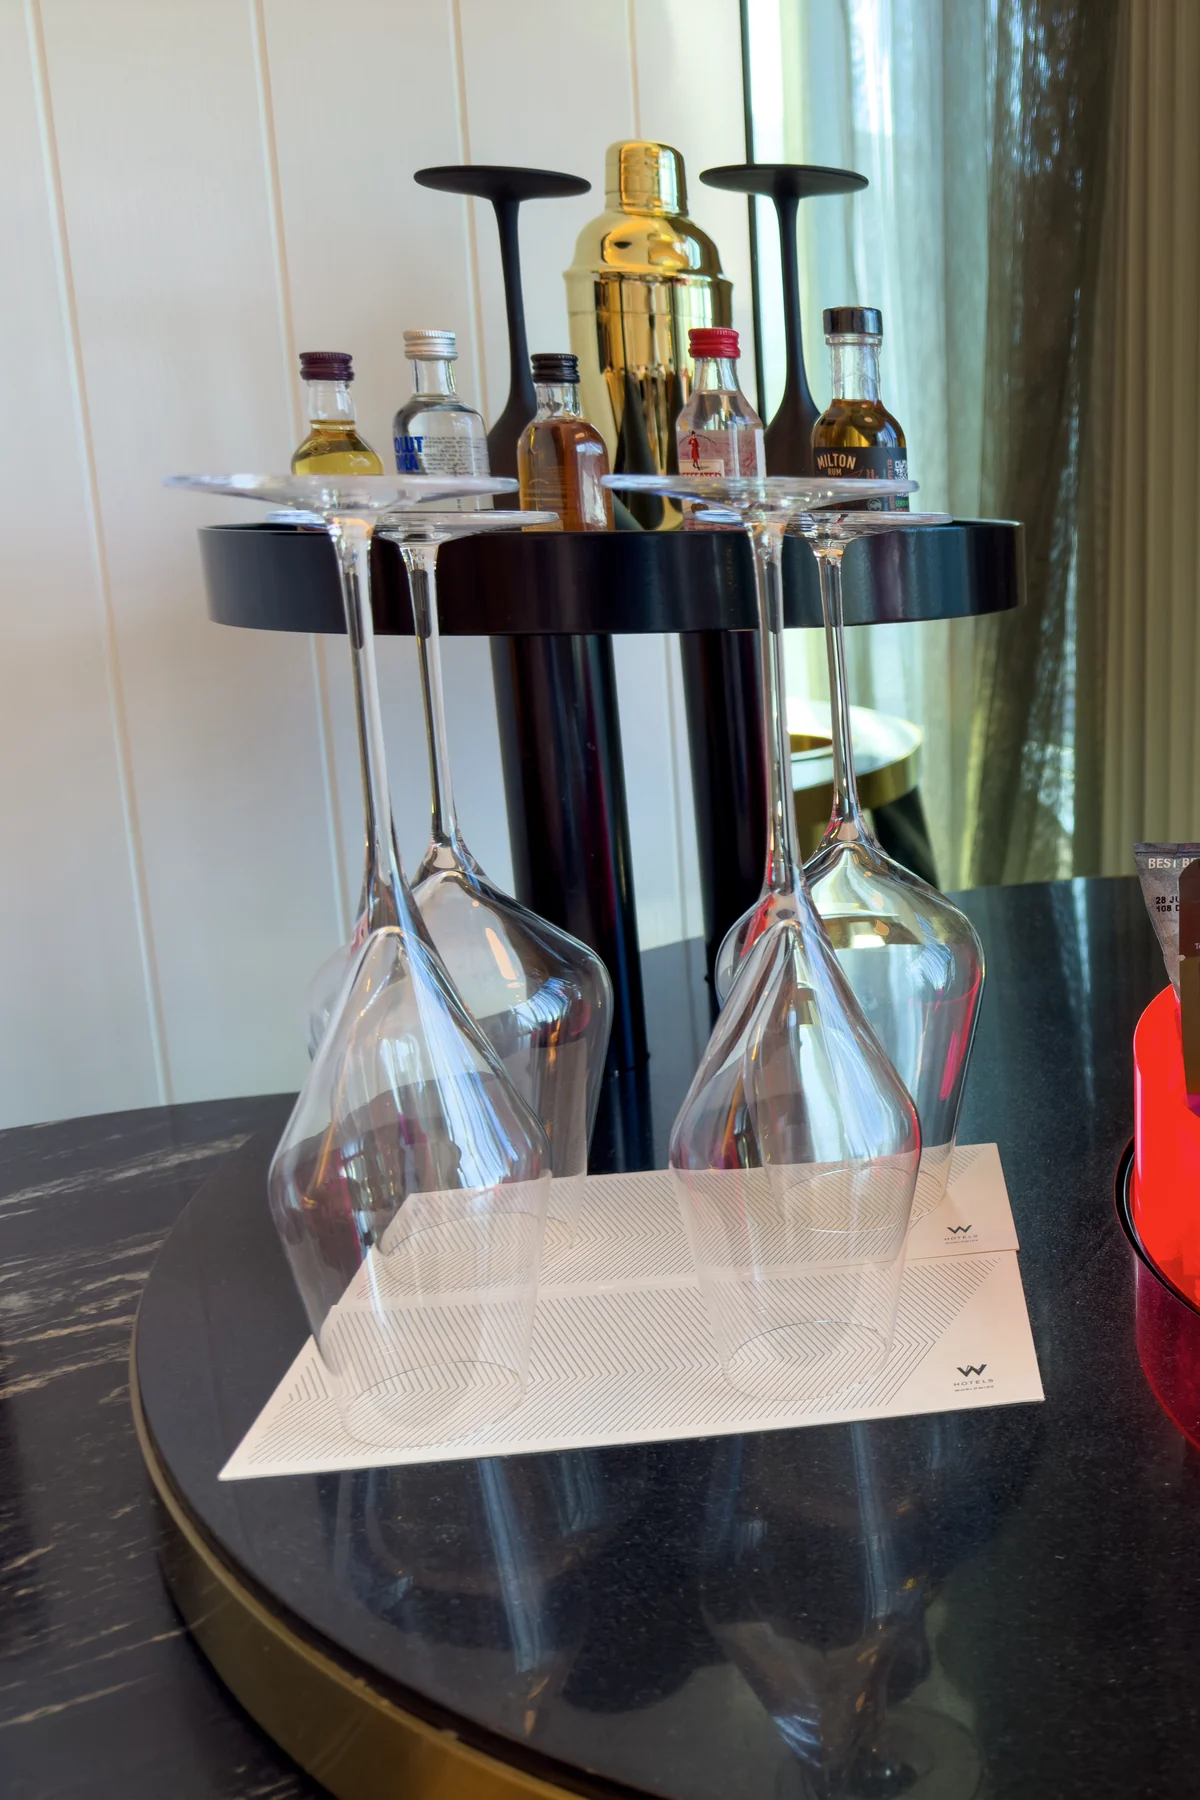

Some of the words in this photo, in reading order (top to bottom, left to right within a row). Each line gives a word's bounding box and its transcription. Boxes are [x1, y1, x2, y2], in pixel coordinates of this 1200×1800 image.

[817, 453, 856, 470] MILTON
[828, 467, 842, 476] RUM
[1148, 858, 1177, 868] BEST
[1156, 896, 1166, 904] 28
[946, 1224, 972, 1234] W
[956, 1363, 988, 1378] W
[953, 1378, 994, 1387] HOTELS
